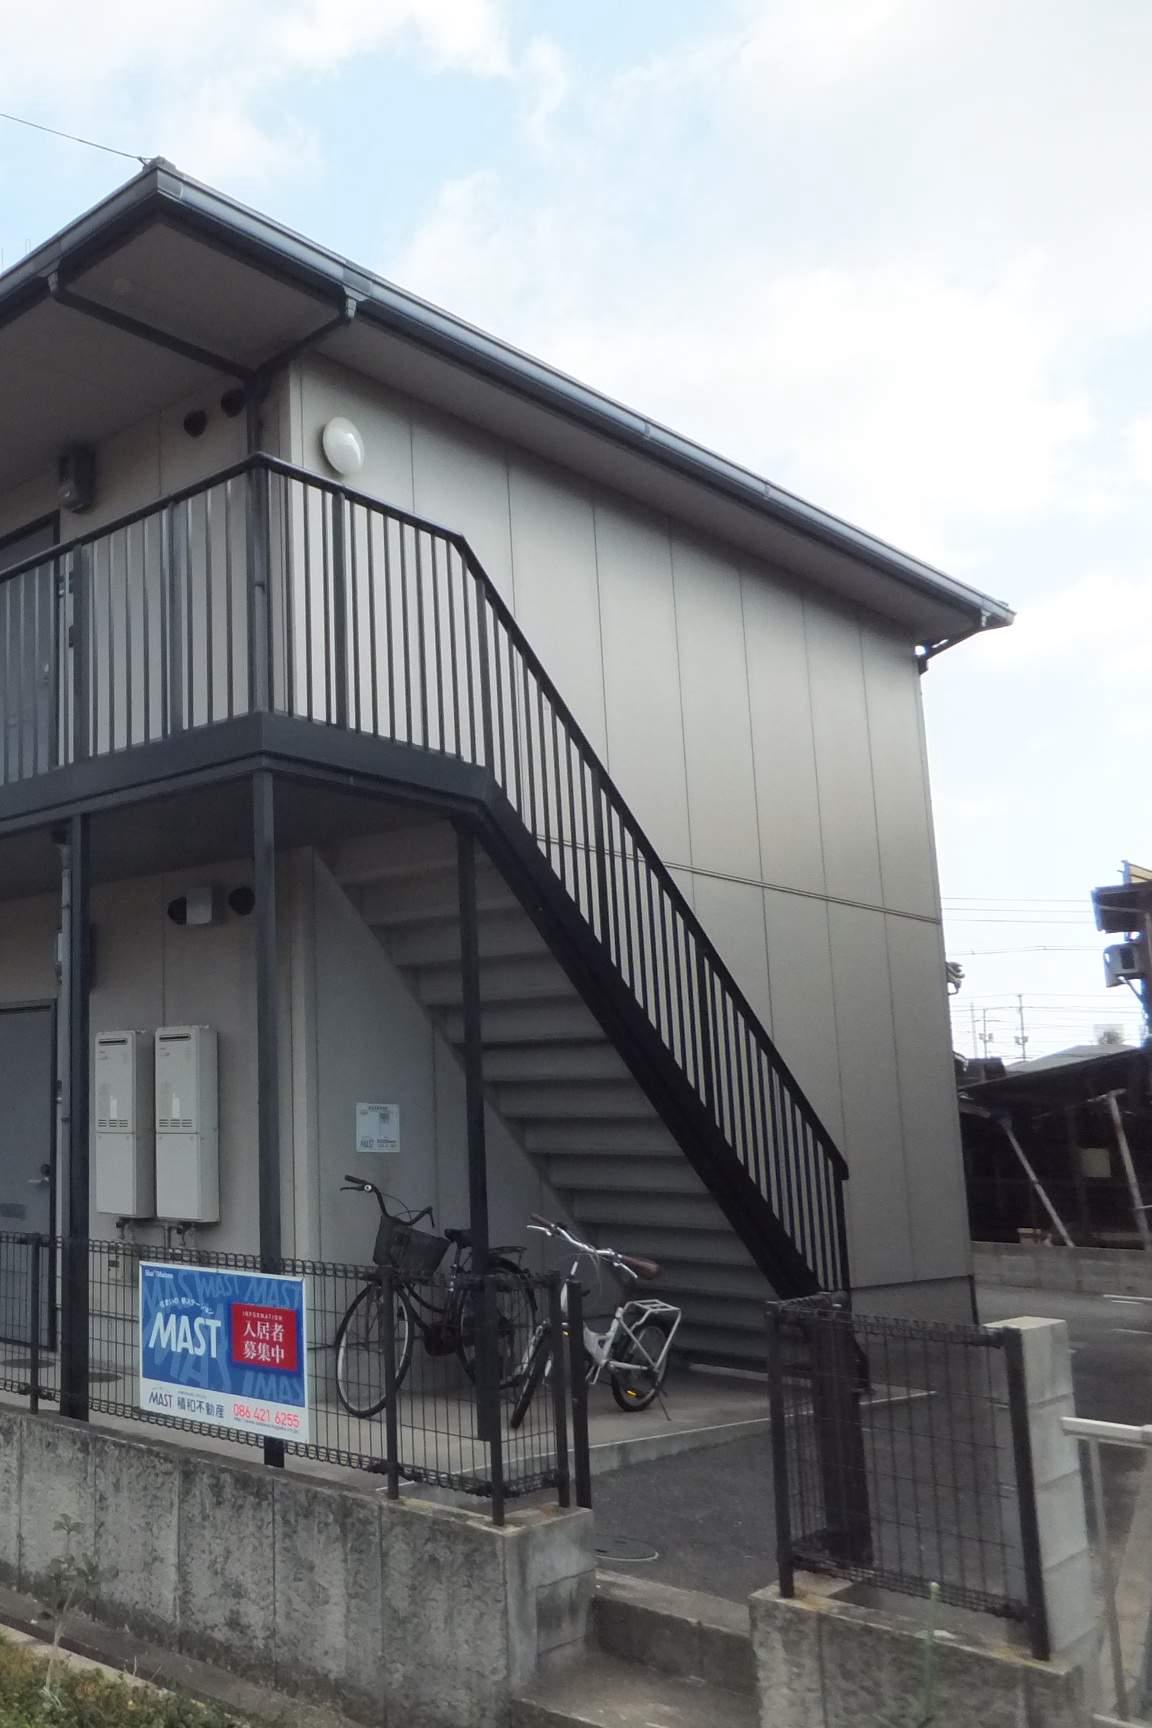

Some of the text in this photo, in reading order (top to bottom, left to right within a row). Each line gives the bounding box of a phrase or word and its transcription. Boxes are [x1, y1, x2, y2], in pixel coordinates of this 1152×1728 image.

[149, 1312, 221, 1358] MAST
[243, 1320, 284, 1342] 入居者
[242, 1340, 284, 1364] 募集中
[149, 1391, 172, 1409] MAST
[233, 1403, 251, 1418] 086
[254, 1407, 271, 1422] 421
[275, 1410, 300, 1428] 6255
